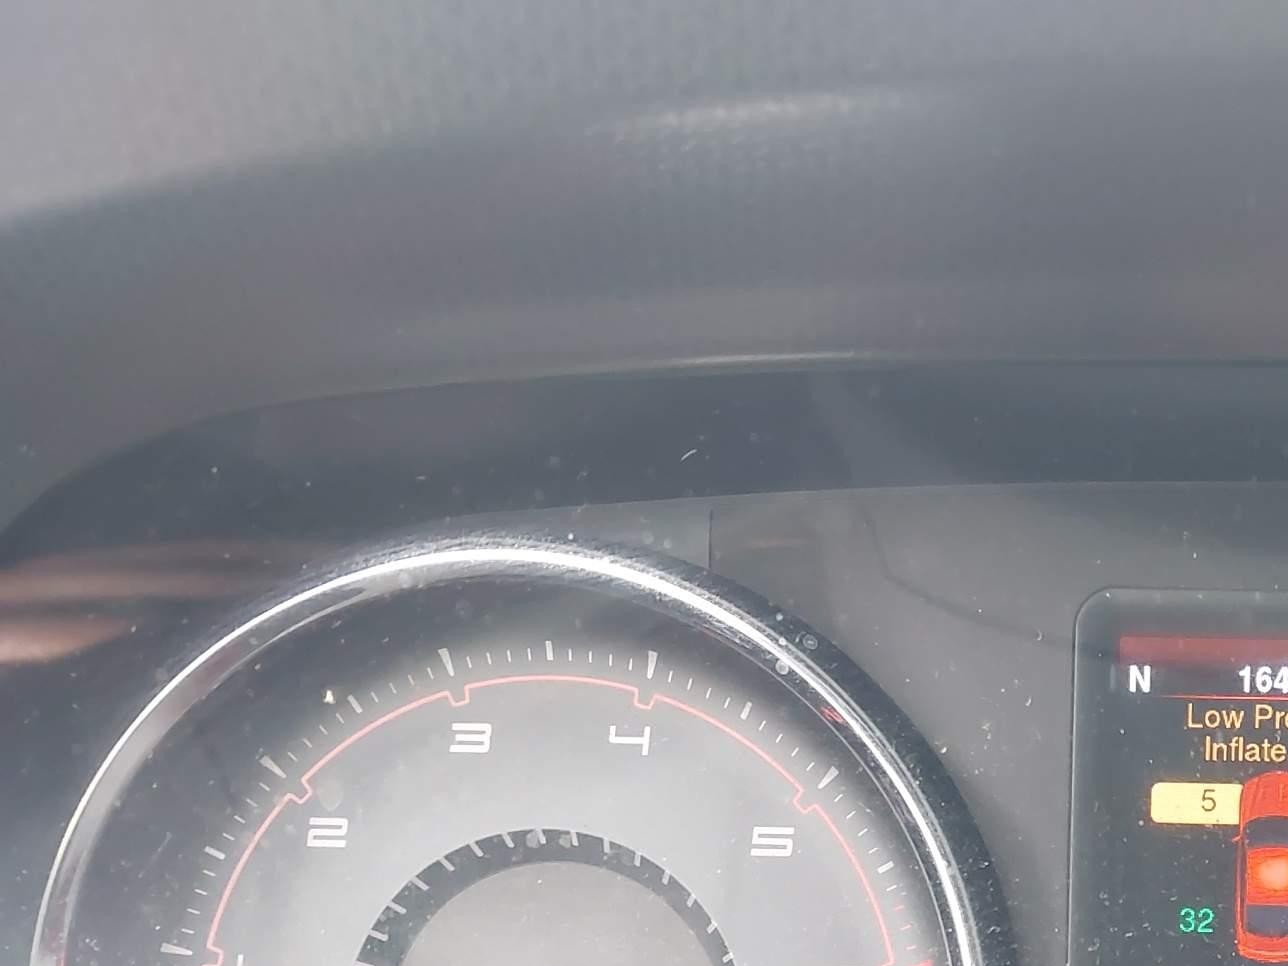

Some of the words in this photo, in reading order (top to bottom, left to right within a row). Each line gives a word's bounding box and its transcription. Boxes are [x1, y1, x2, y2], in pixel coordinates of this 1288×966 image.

[1129, 666, 1151, 693] N
[1187, 704, 1243, 729] Low
[450, 722, 492, 753] 3
[608, 725, 652, 755] 4
[1205, 736, 1286, 763] Inflate
[1201, 790, 1216, 811] 5
[307, 817, 349, 848] 2
[750, 826, 795, 857] 5
[1179, 909, 1214, 933] 32
